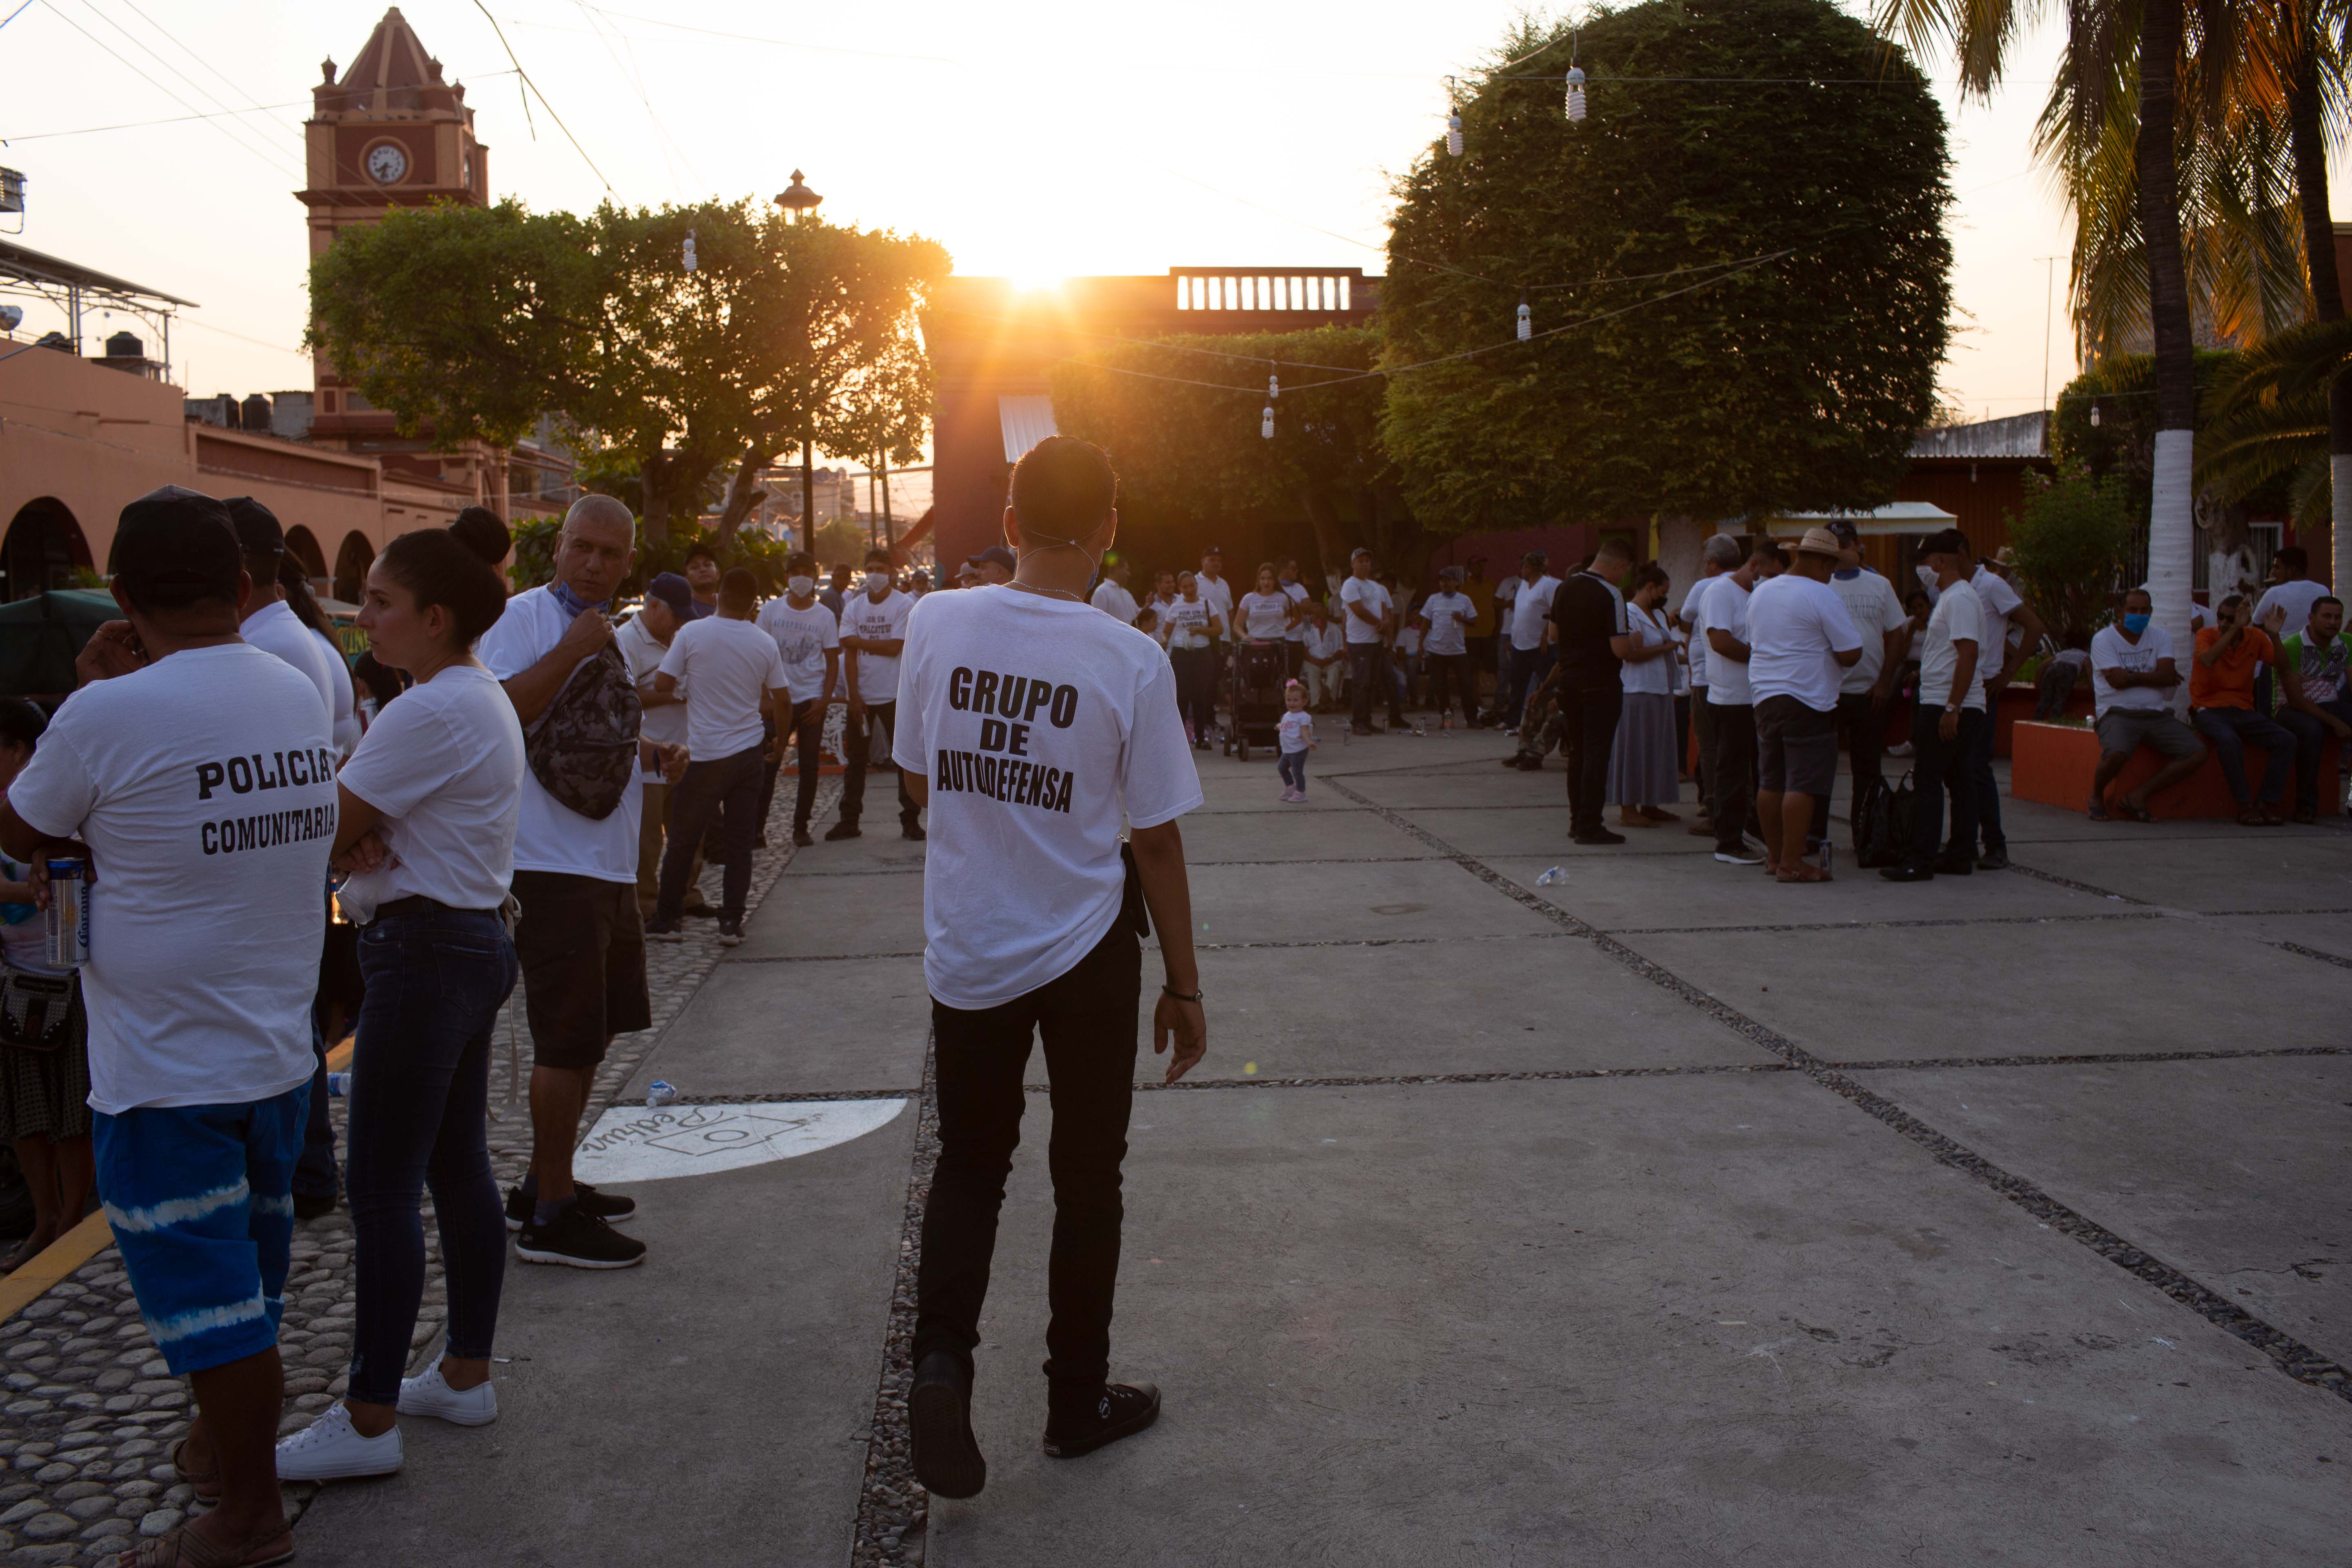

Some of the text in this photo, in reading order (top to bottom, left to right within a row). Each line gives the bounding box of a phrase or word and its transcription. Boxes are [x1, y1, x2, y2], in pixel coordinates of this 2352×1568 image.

[949, 666, 1078, 729] GRUPO
[980, 718, 1030, 757] DE
[196, 748, 332, 800] POLICIA
[937, 749, 1074, 814] AUTODEFENSA
[202, 803, 334, 855] COMUNITARIA
[78, 886, 89, 948] Corona
